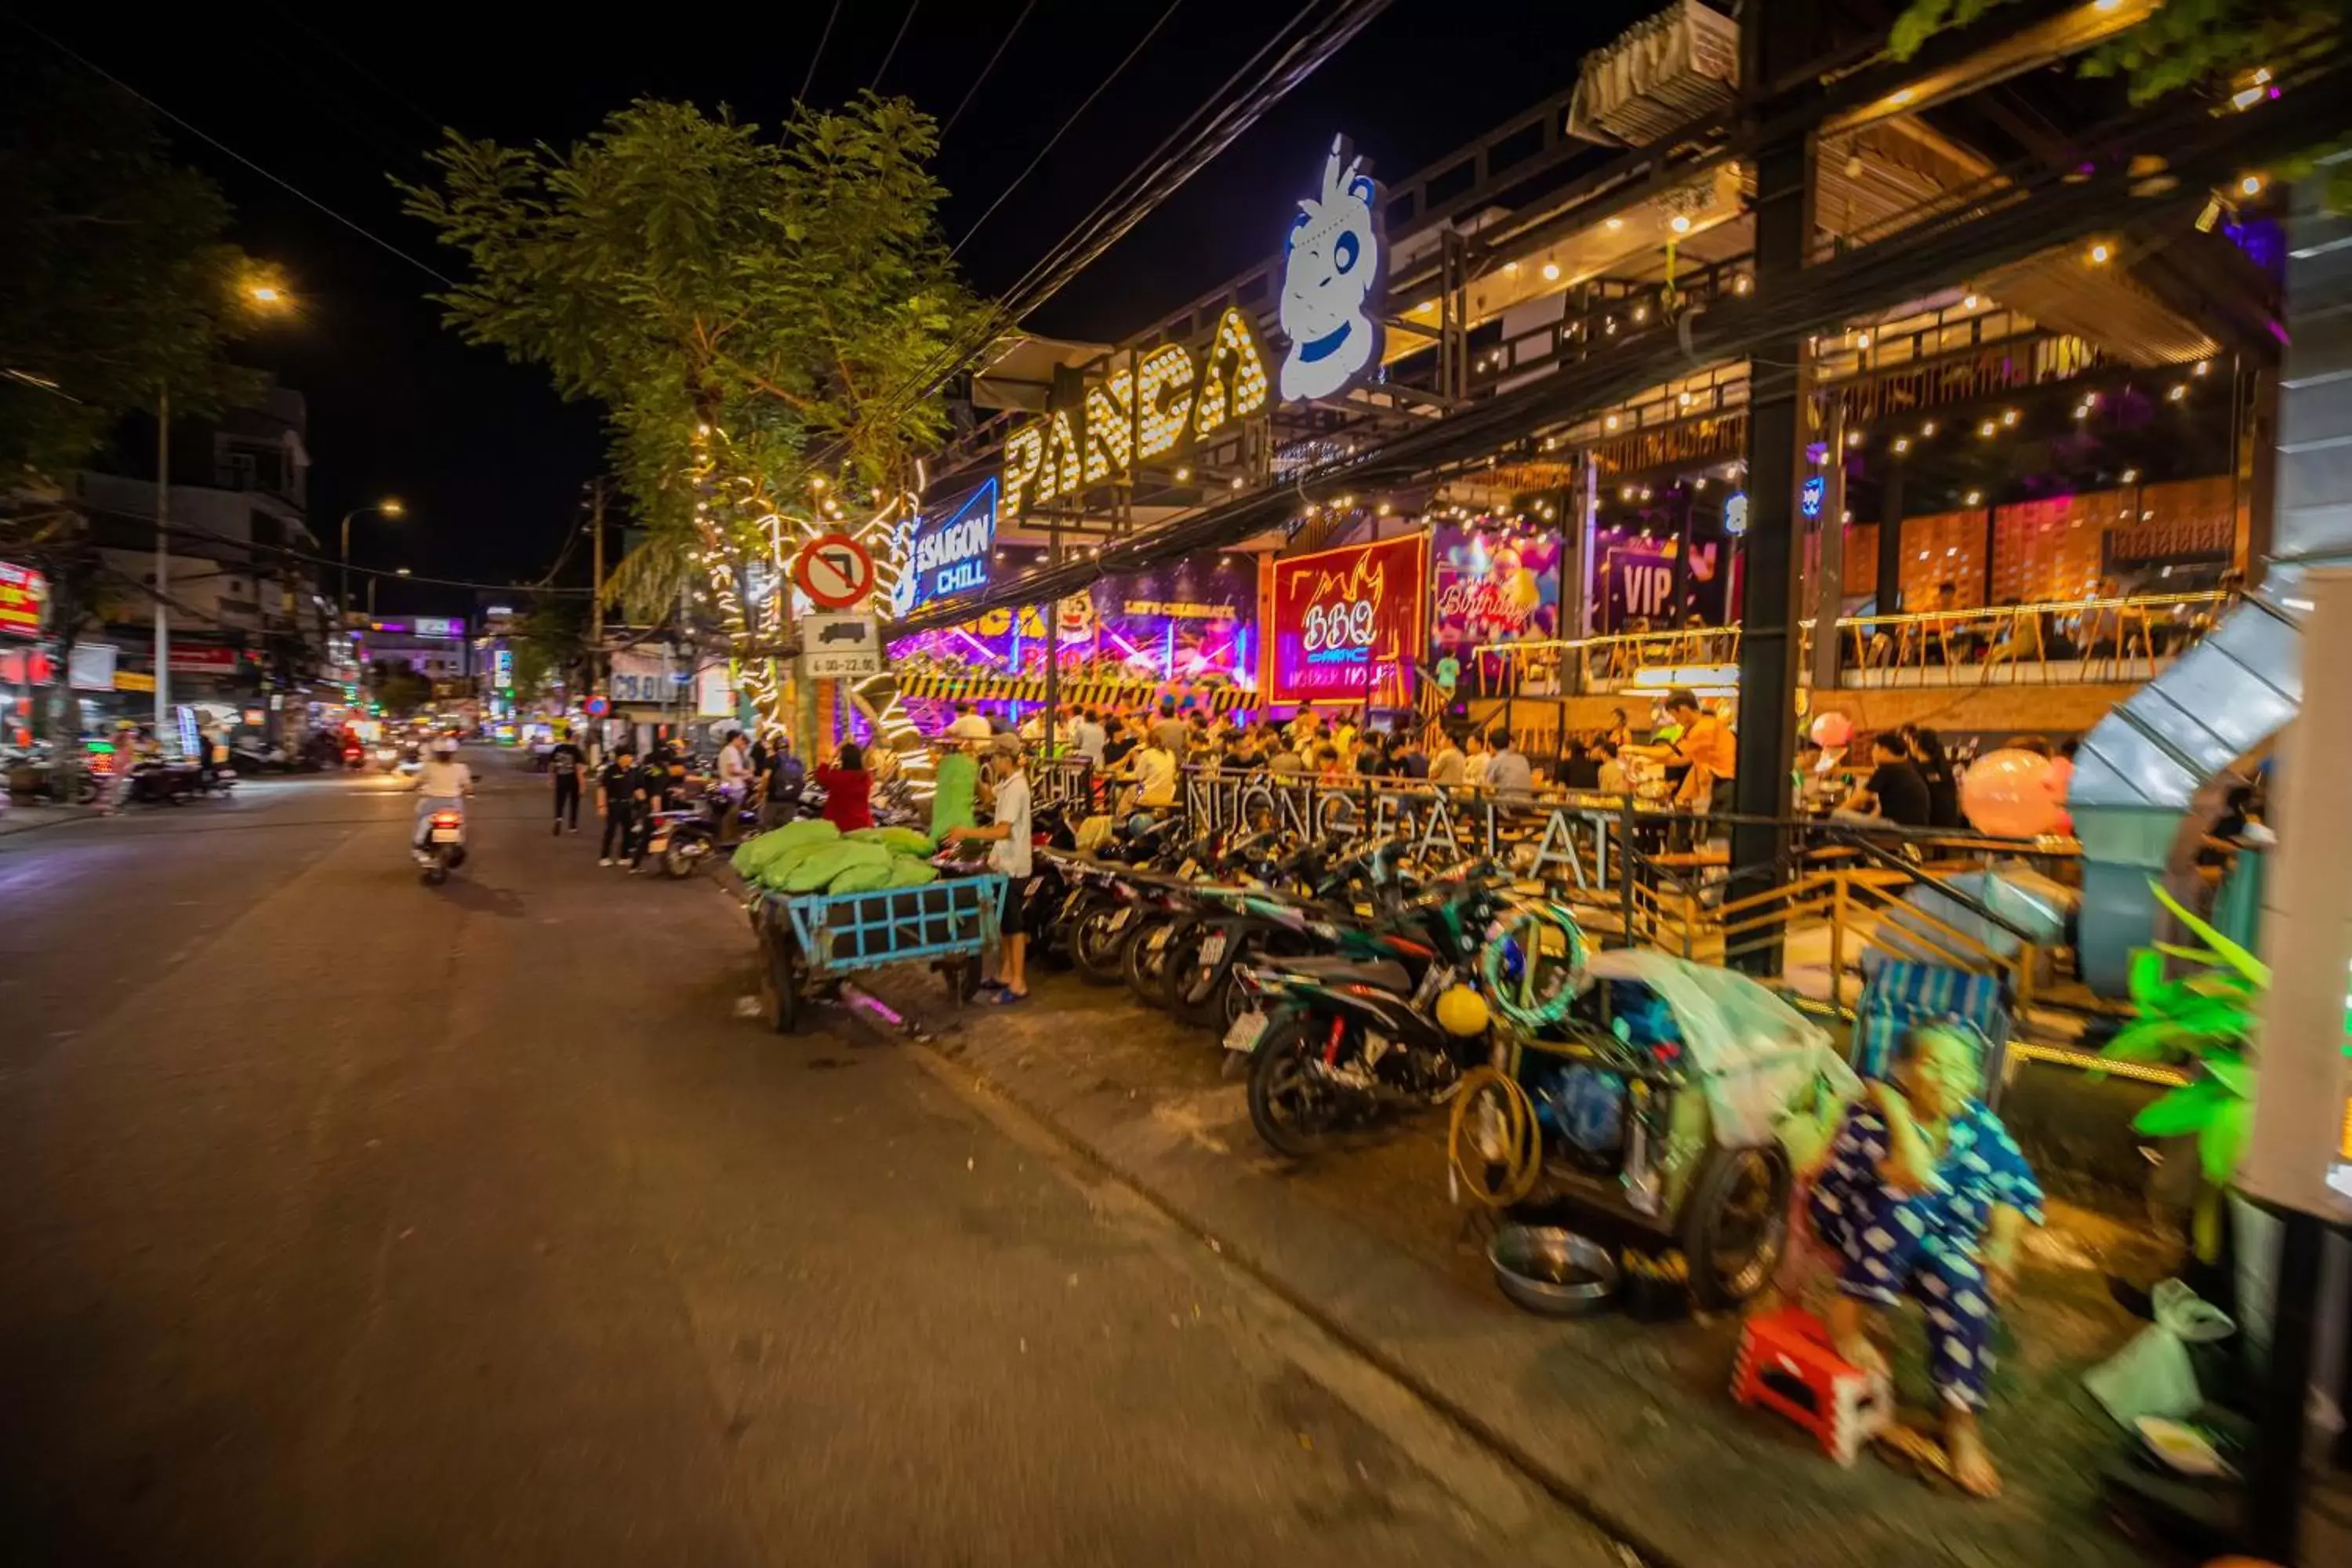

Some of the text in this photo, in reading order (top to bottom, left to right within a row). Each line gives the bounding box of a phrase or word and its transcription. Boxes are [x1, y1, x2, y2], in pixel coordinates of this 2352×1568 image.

[937, 560, 987, 594] CHILL
[1624, 564, 1671, 615] VIP
[1303, 599, 1377, 652] BBQ
